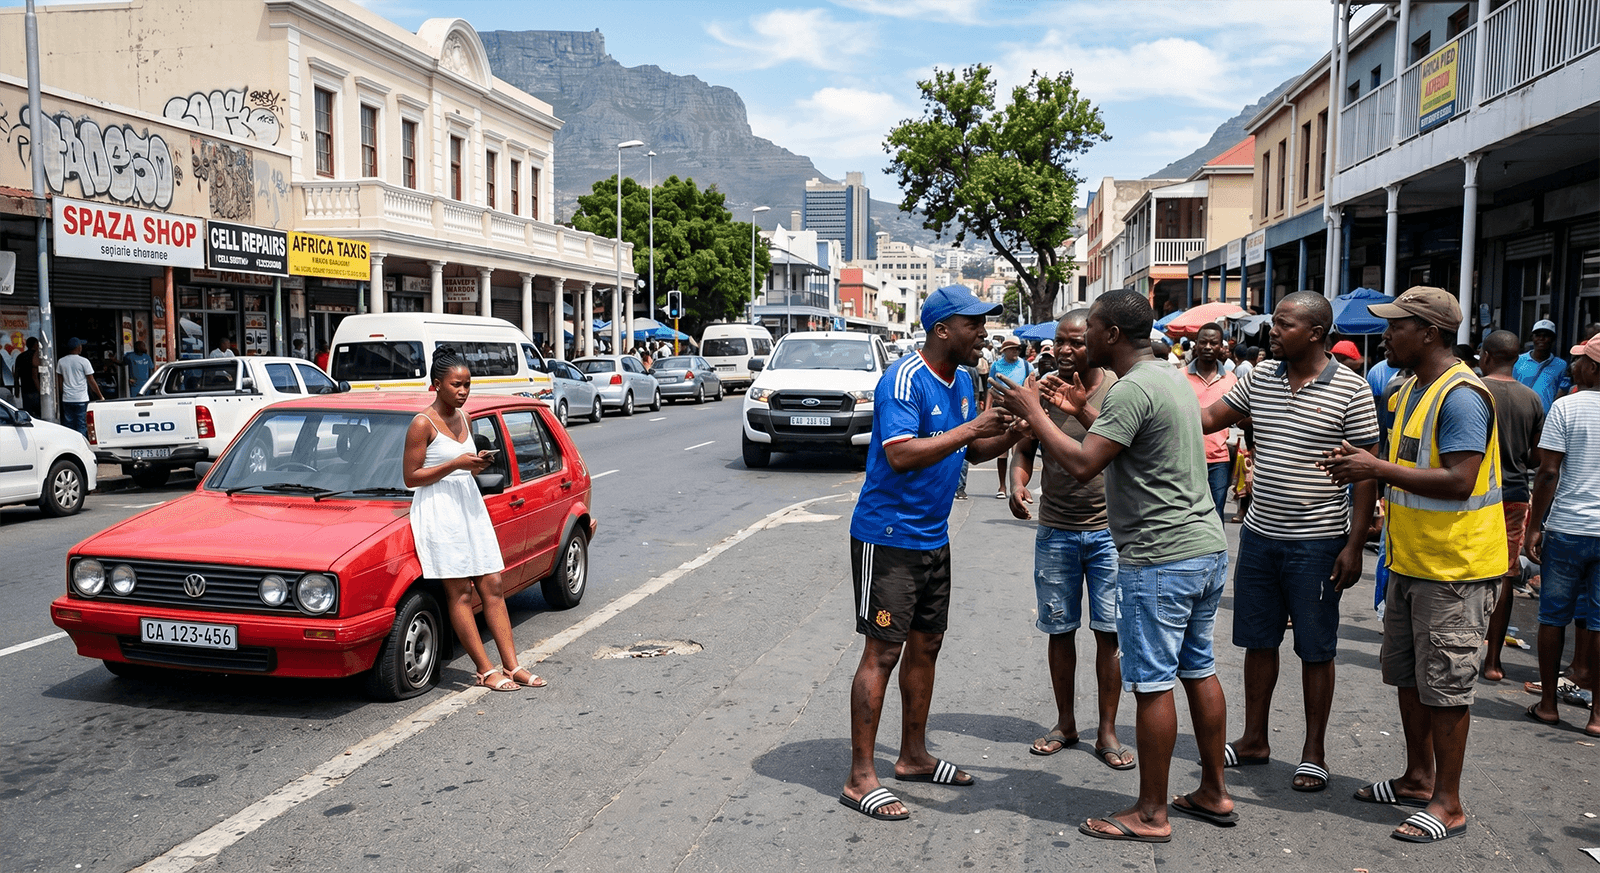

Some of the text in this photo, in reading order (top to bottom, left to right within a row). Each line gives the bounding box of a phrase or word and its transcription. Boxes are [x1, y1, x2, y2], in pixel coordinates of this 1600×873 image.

[63, 205, 197, 248] SPAZA SHOP
[211, 227, 286, 257] CELL REPAIRS
[292, 235, 367, 260] AFRICA TAXIS
[116, 421, 175, 434] FORD
[146, 623, 231, 645] CA 123-456
